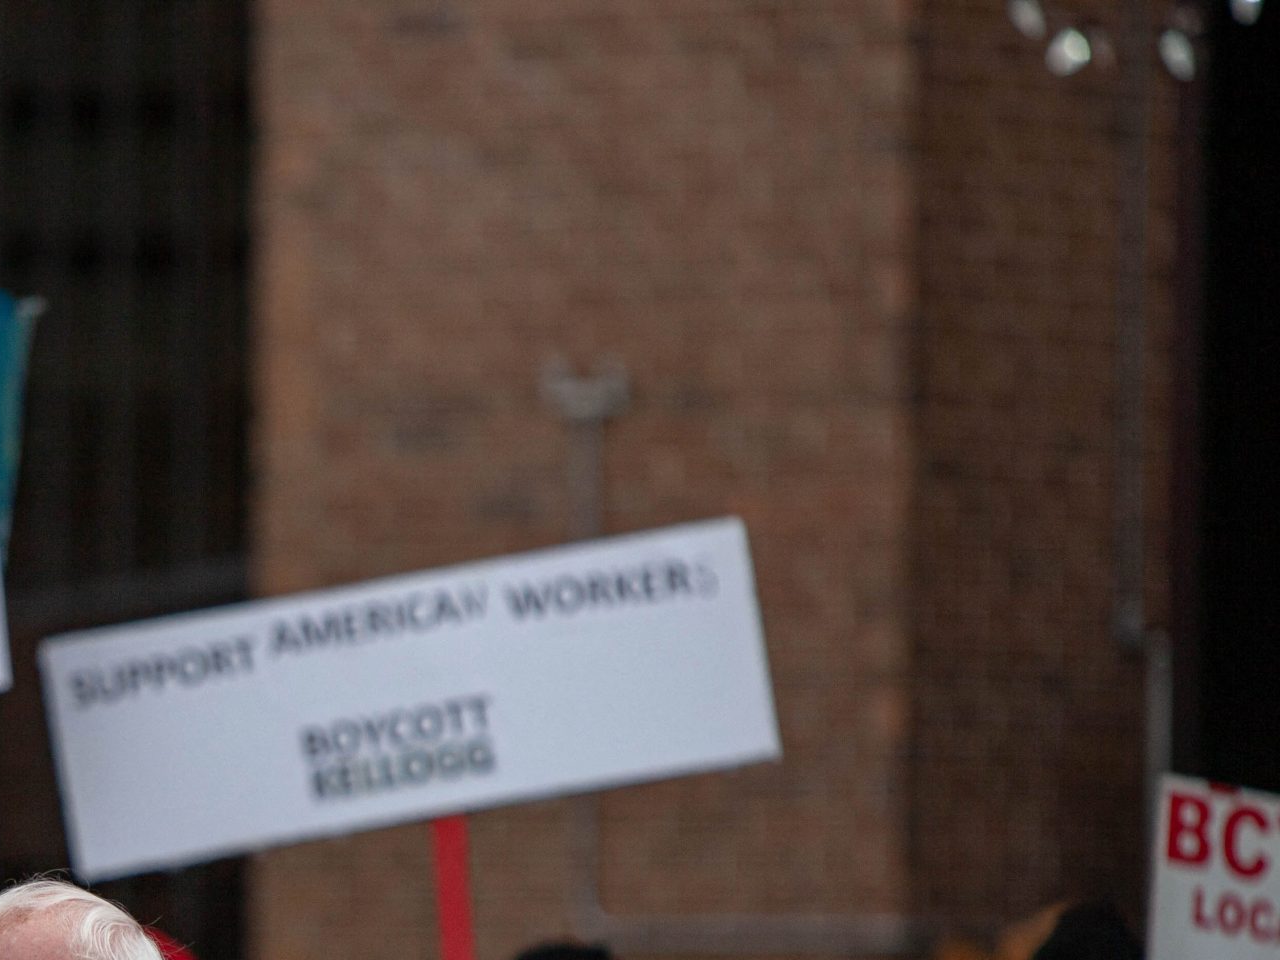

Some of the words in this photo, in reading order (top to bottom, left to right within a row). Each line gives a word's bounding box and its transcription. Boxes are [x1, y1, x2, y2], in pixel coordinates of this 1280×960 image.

[68, 636, 255, 709] SUPPORT
[268, 582, 488, 655] AMERICAN
[501, 555, 720, 618] WORKERS
[298, 694, 491, 759] BOYCOTT
[1168, 791, 1280, 880] BC
[1192, 885, 1280, 944] LOC
